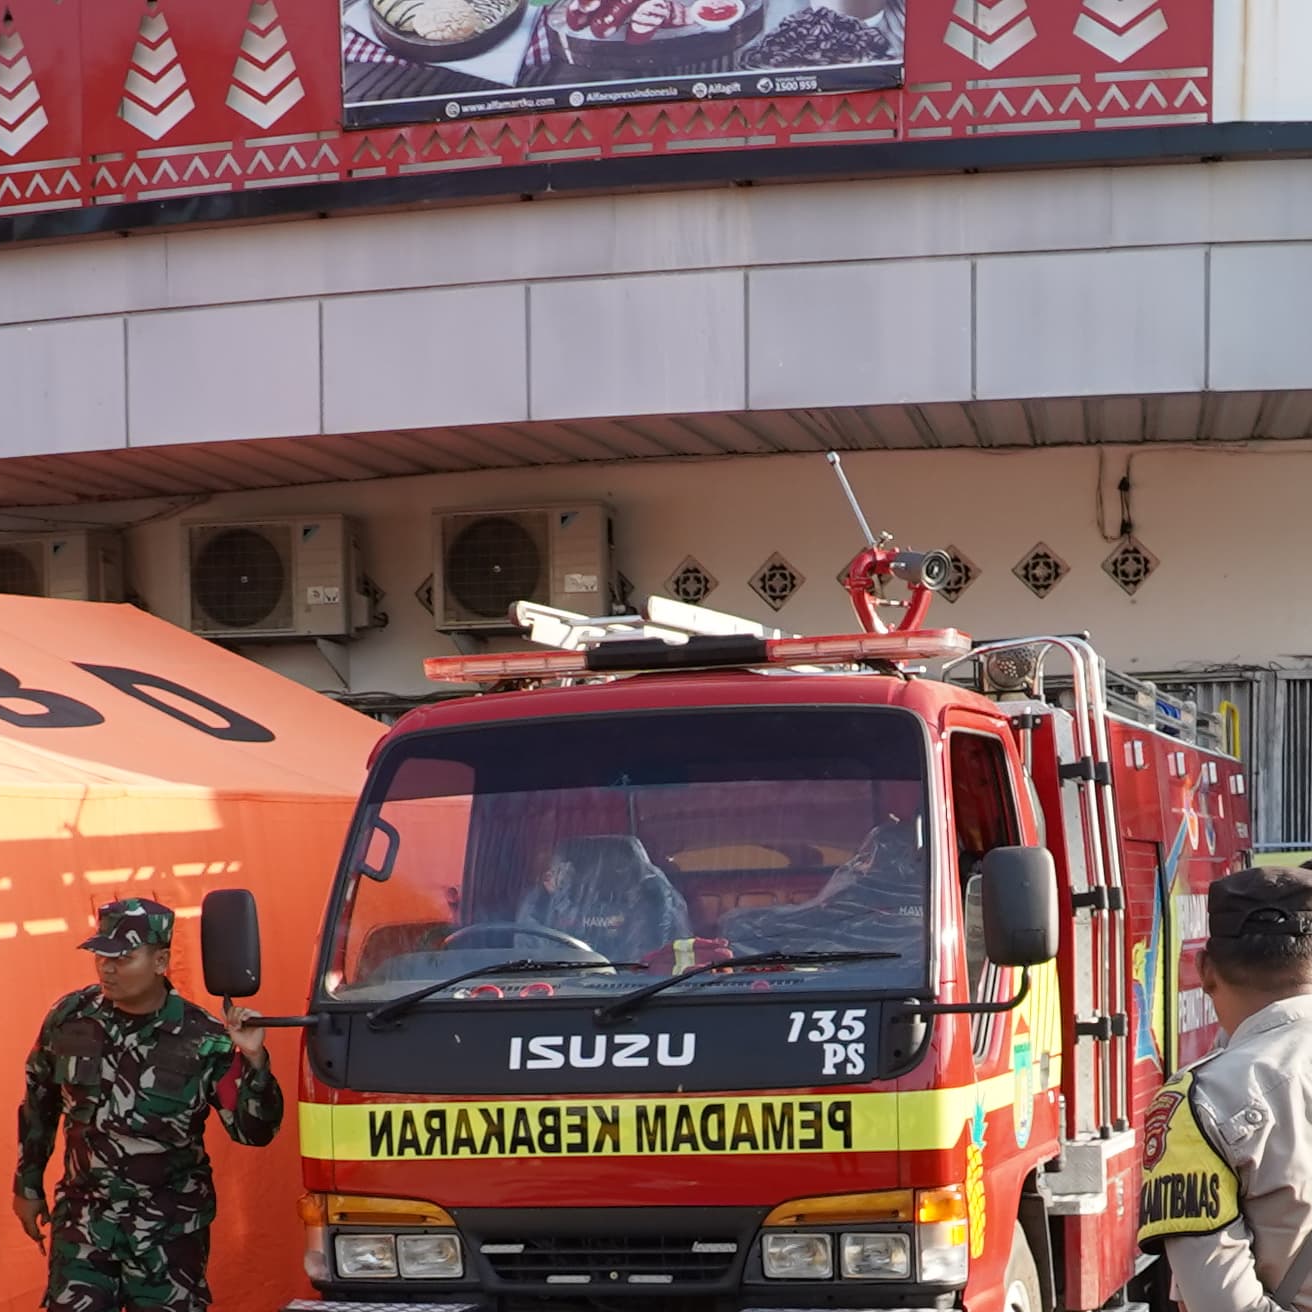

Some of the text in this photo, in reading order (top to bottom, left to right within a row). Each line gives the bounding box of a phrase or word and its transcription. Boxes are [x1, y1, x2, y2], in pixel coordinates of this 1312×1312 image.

[775, 79, 818, 92] 1500 959
[787, 1008, 866, 1044] 135
[509, 1033, 696, 1070] ISUZU
[822, 1042, 866, 1075] PS
